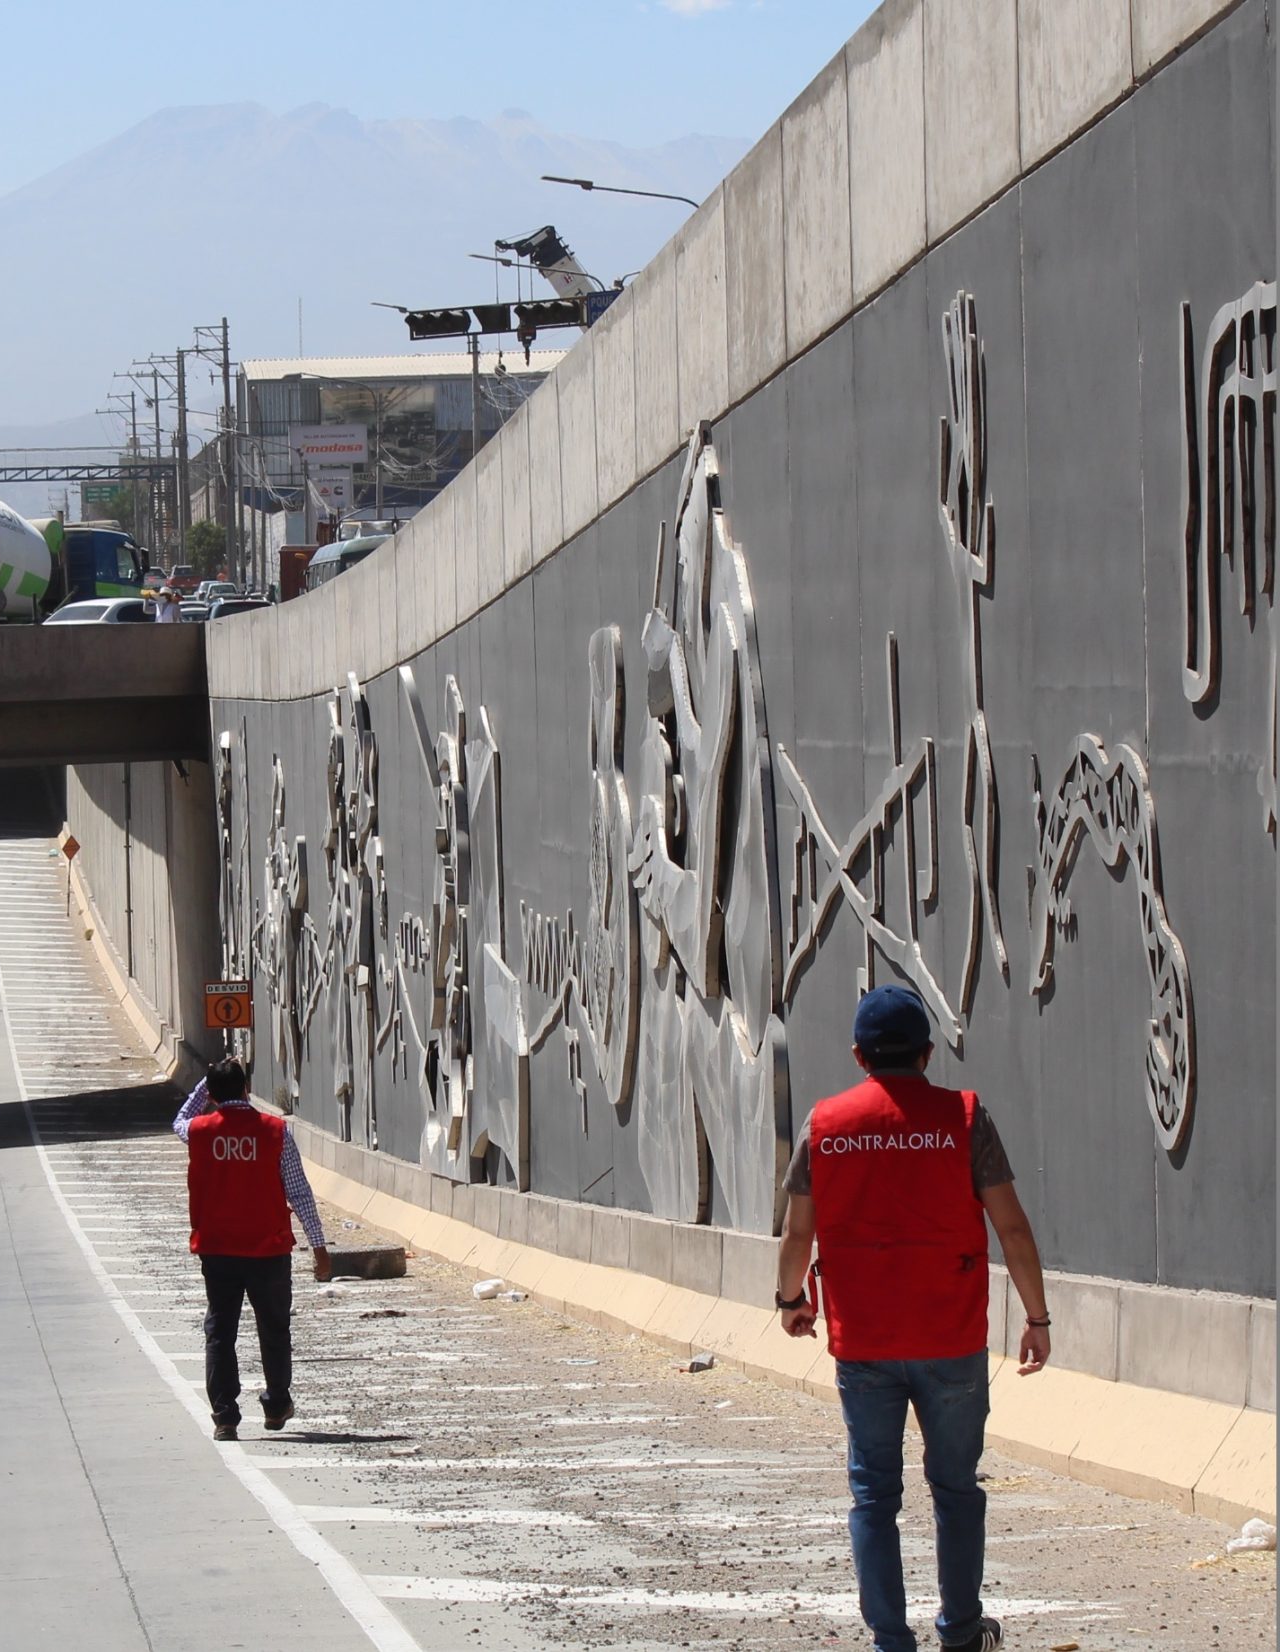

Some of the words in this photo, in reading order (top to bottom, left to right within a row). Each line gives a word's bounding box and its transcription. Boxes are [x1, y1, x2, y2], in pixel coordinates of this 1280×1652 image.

[305, 443, 363, 453] modasa
[212, 1135, 257, 1161] ORCI
[820, 1129, 956, 1155] CONTRALORÍA
